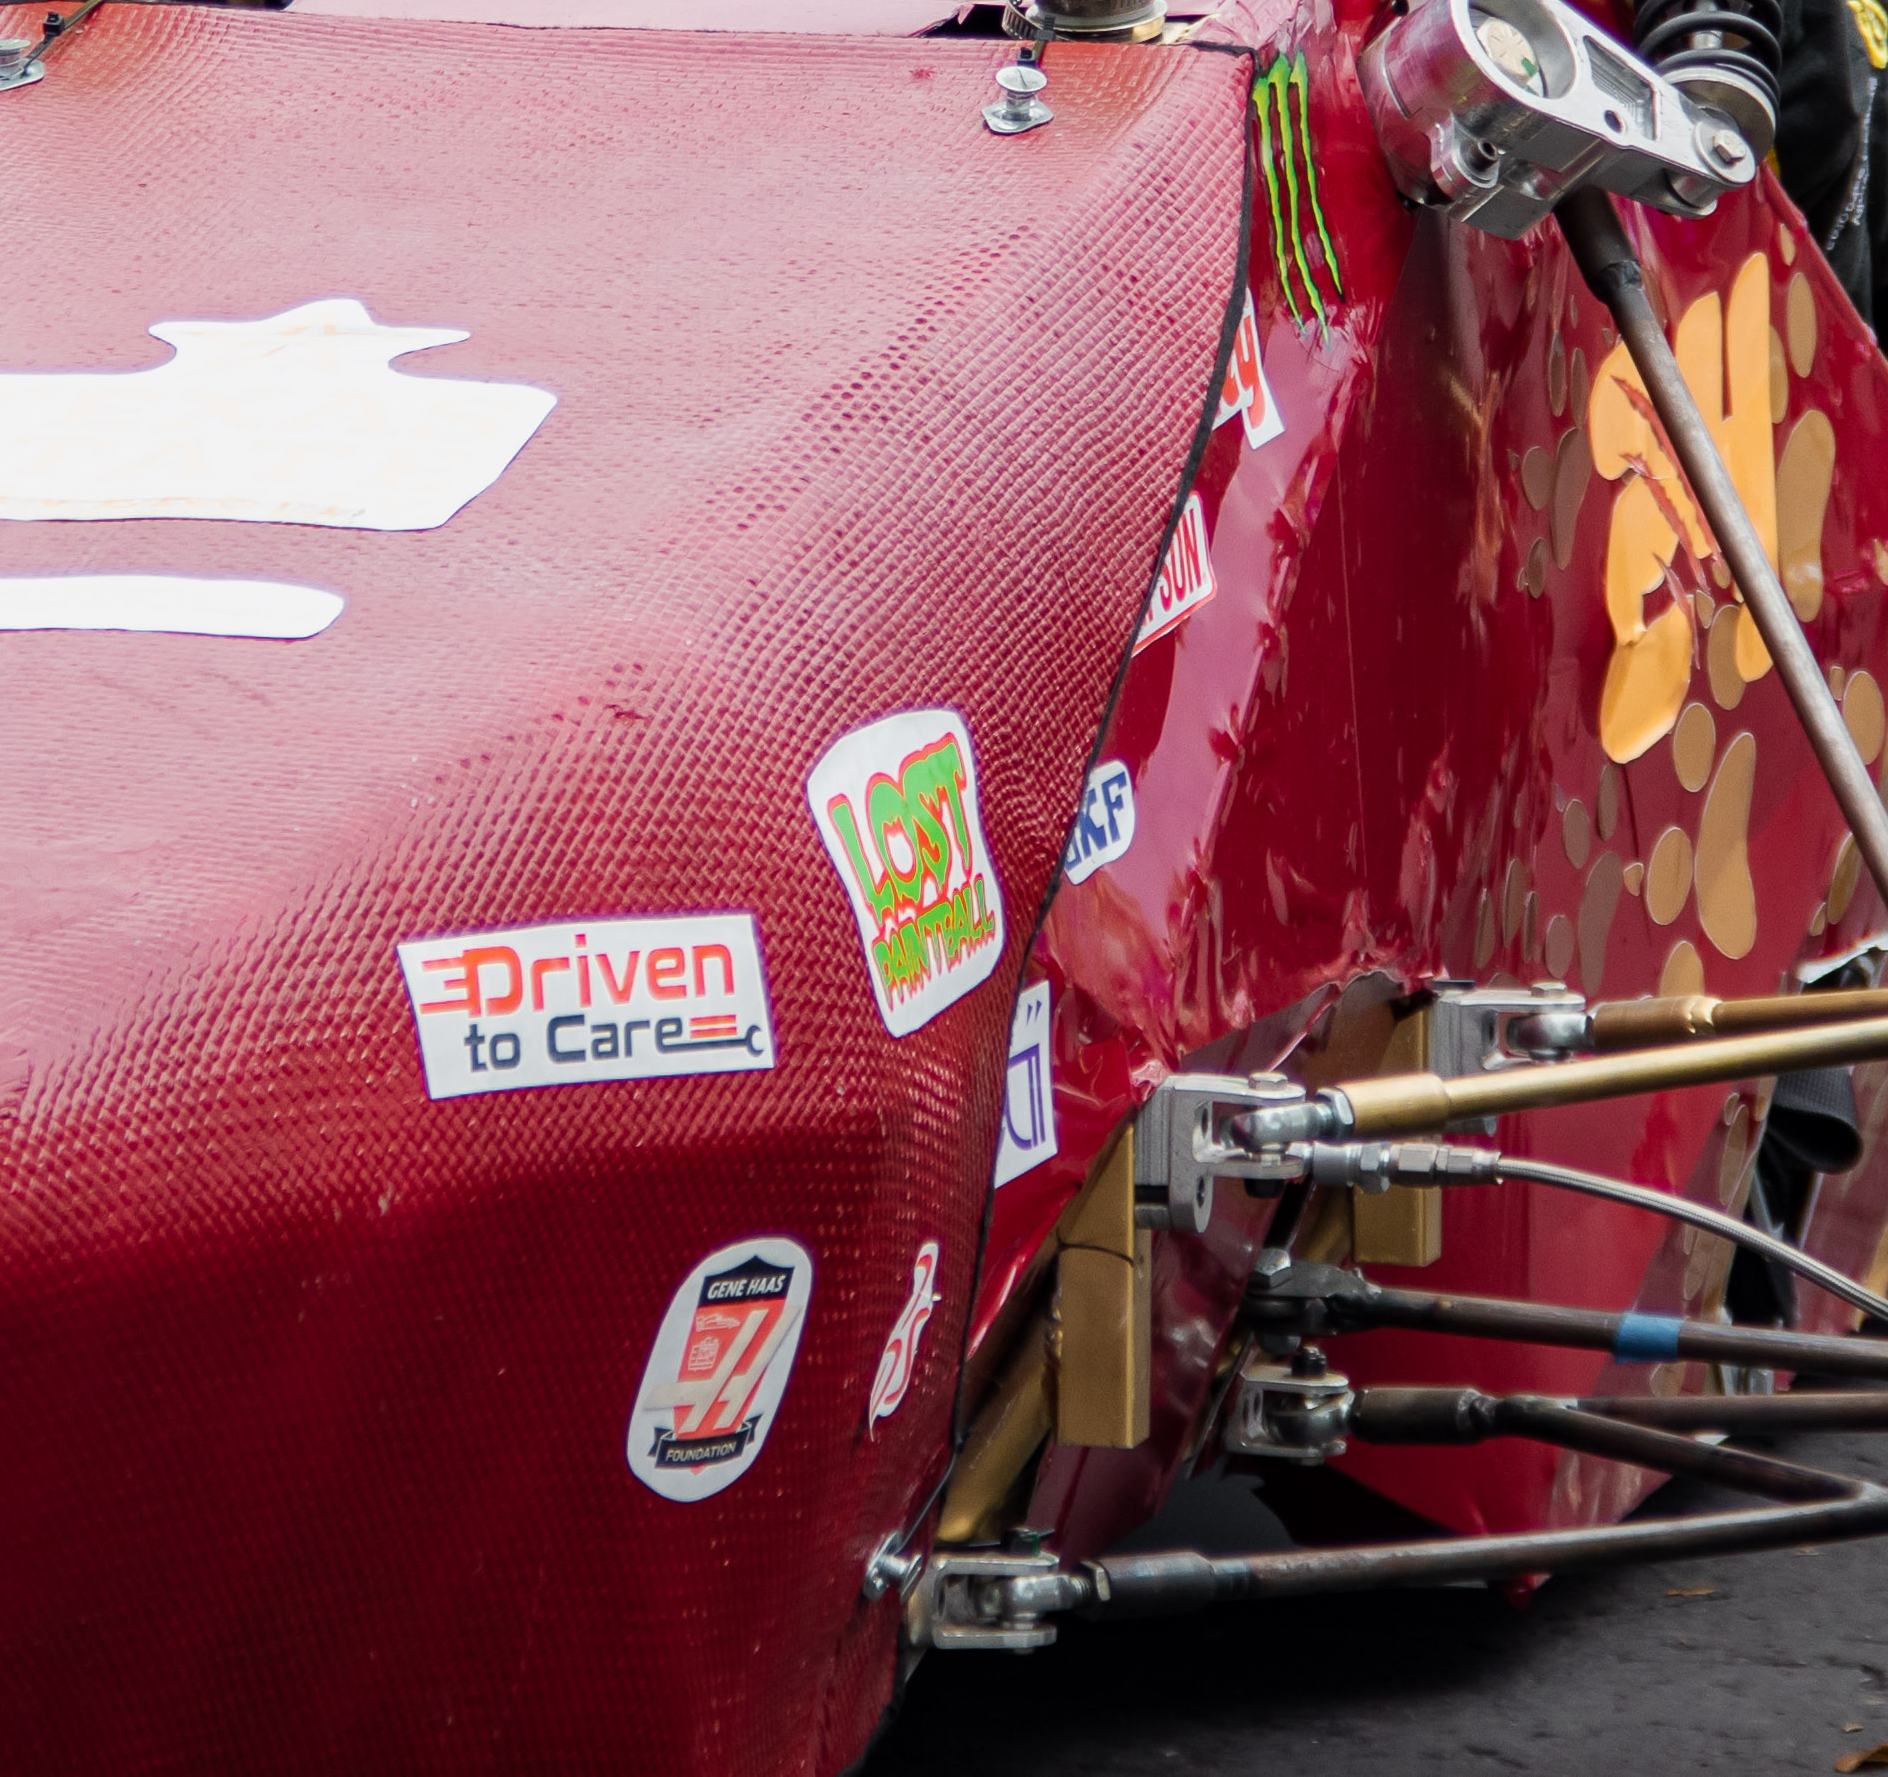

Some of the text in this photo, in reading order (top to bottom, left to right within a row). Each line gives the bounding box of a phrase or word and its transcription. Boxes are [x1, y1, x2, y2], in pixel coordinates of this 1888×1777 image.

[827, 731, 973, 937] LOST
[420, 934, 735, 1017] Driven
[872, 872, 995, 1013] PAINTBALL
[464, 1004, 683, 1072] to Care
[706, 1275, 786, 1301] GENE HAAS
[664, 1441, 738, 1463] FOUNDATION
